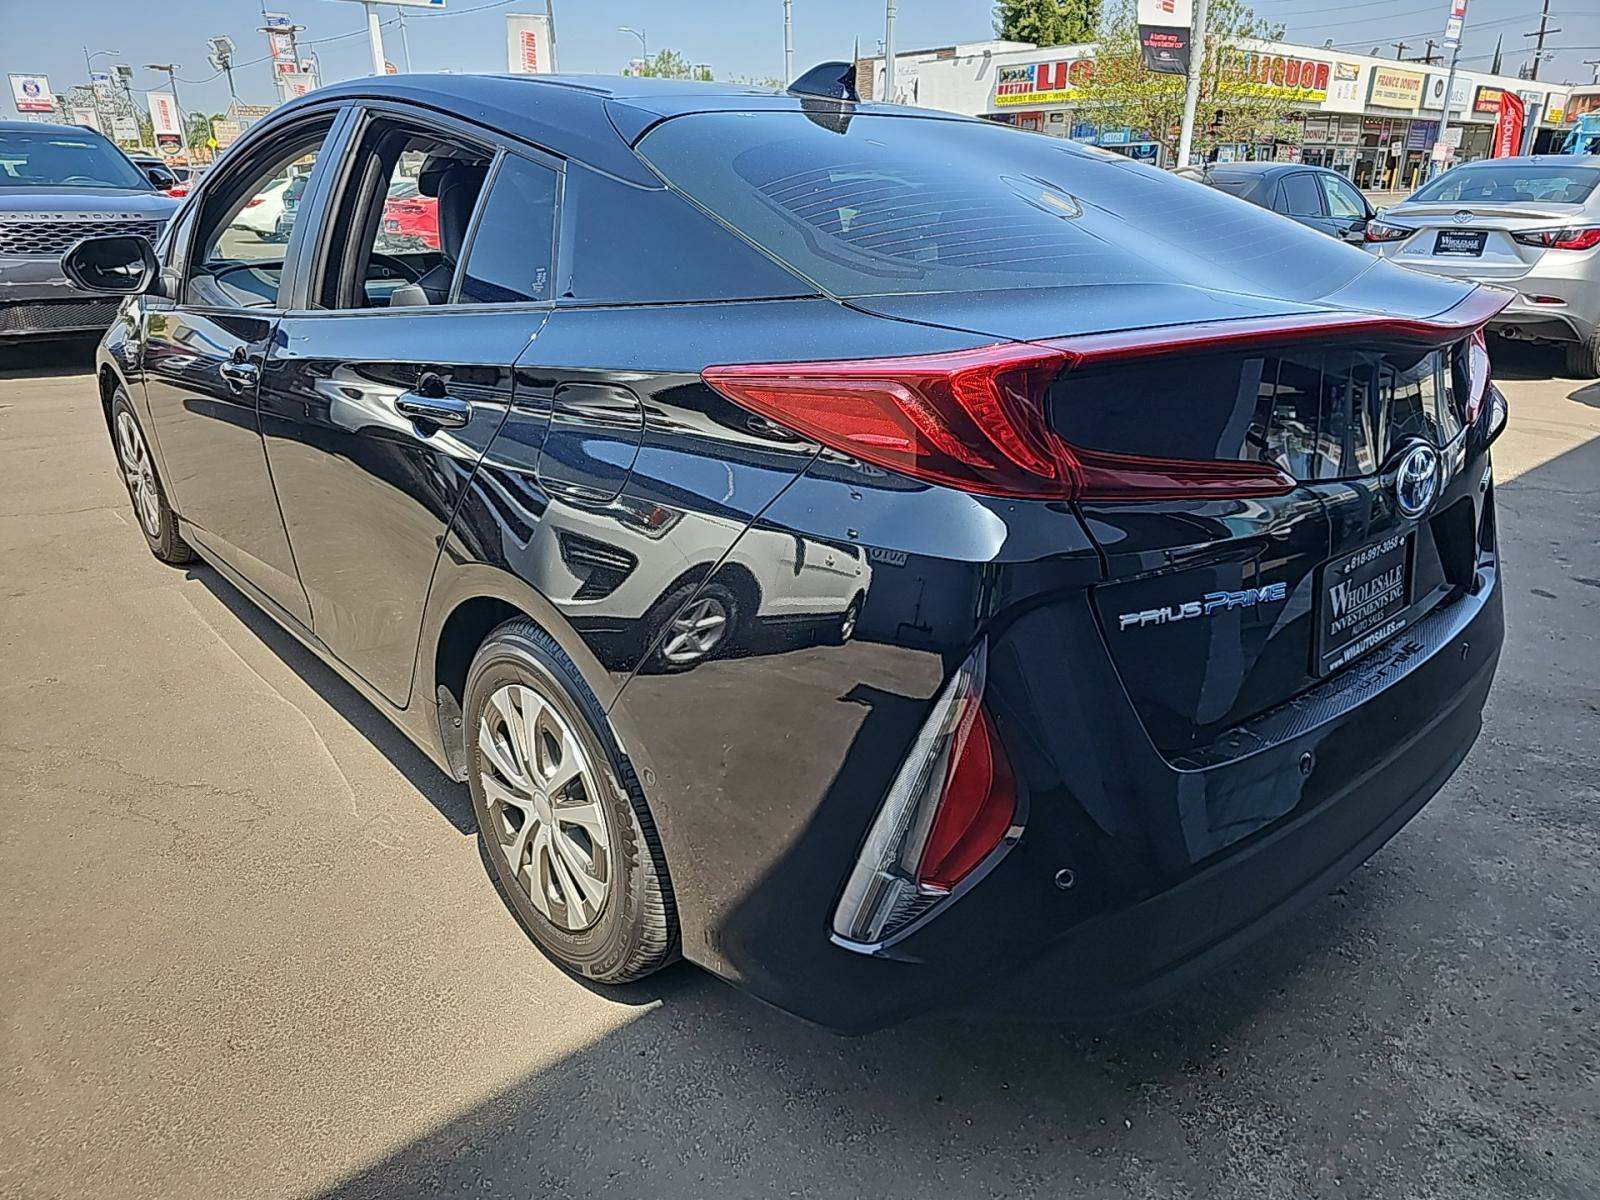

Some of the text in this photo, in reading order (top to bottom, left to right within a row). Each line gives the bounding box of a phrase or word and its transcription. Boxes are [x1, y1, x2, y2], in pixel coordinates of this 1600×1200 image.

[1250, 55, 1330, 90] LIQUOR
[1118, 581, 1287, 631] PRIUS PRIME
[1329, 564, 1403, 618] WHOLESALE
[1330, 593, 1389, 635] INVESTMENTS
